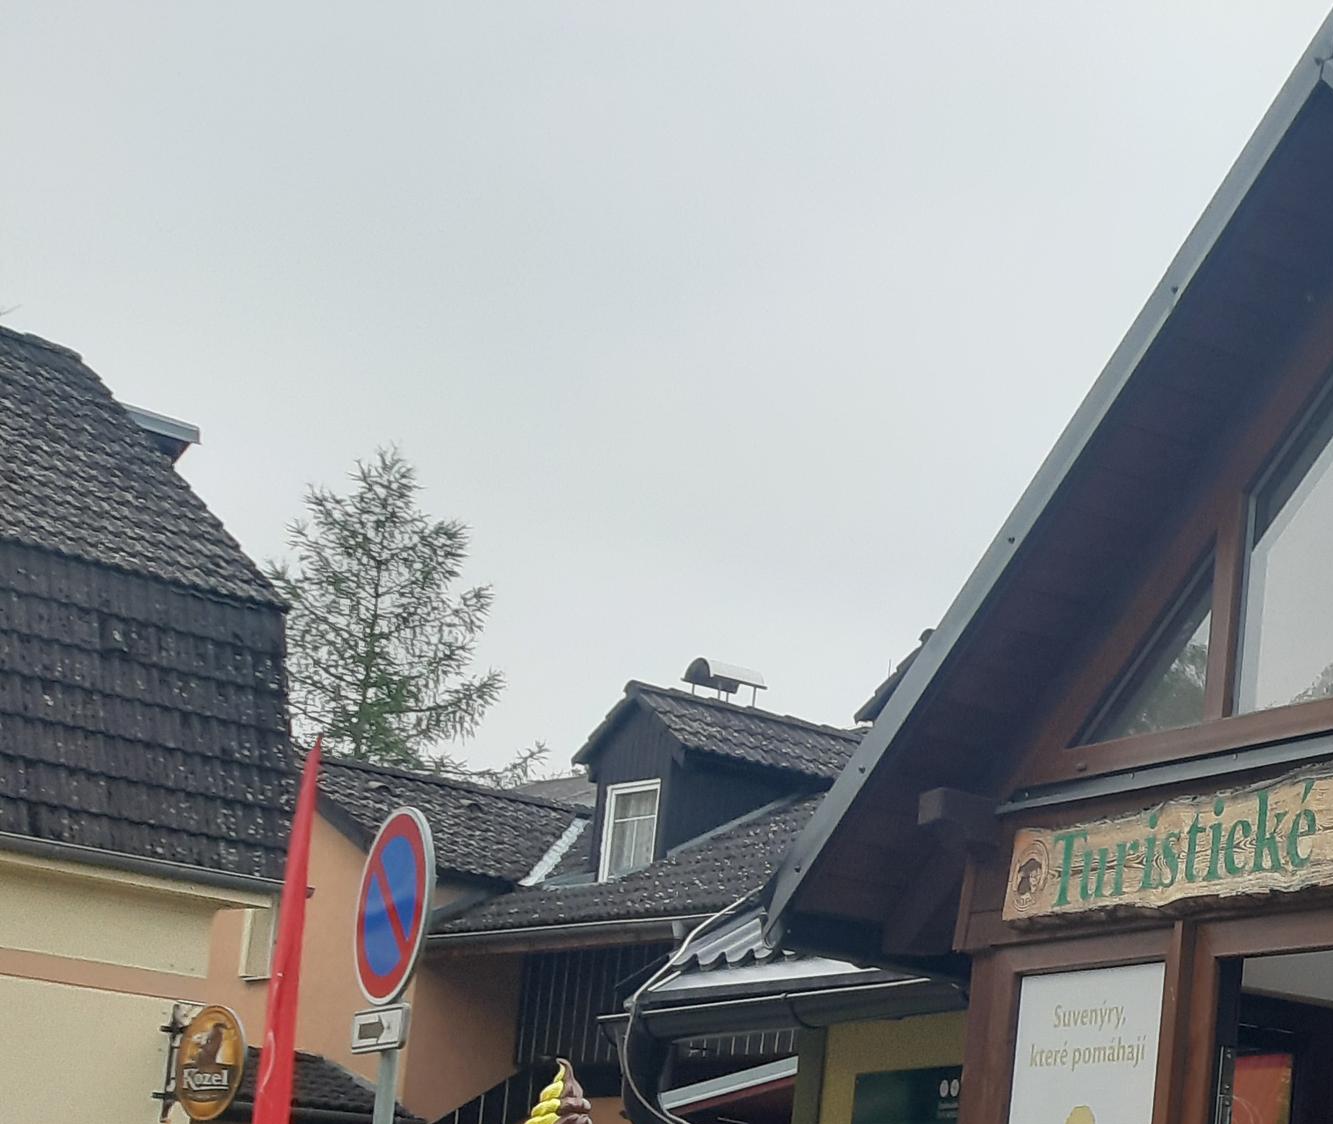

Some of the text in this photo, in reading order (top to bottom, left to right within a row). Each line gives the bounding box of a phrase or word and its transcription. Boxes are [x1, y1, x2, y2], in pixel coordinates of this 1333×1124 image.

[1051, 778, 1317, 908] Turistické
[1053, 1000, 1127, 1031] Suvenýry,
[1029, 1034, 1148, 1072] které pomáhají
[183, 1068, 229, 1091] Kozel
